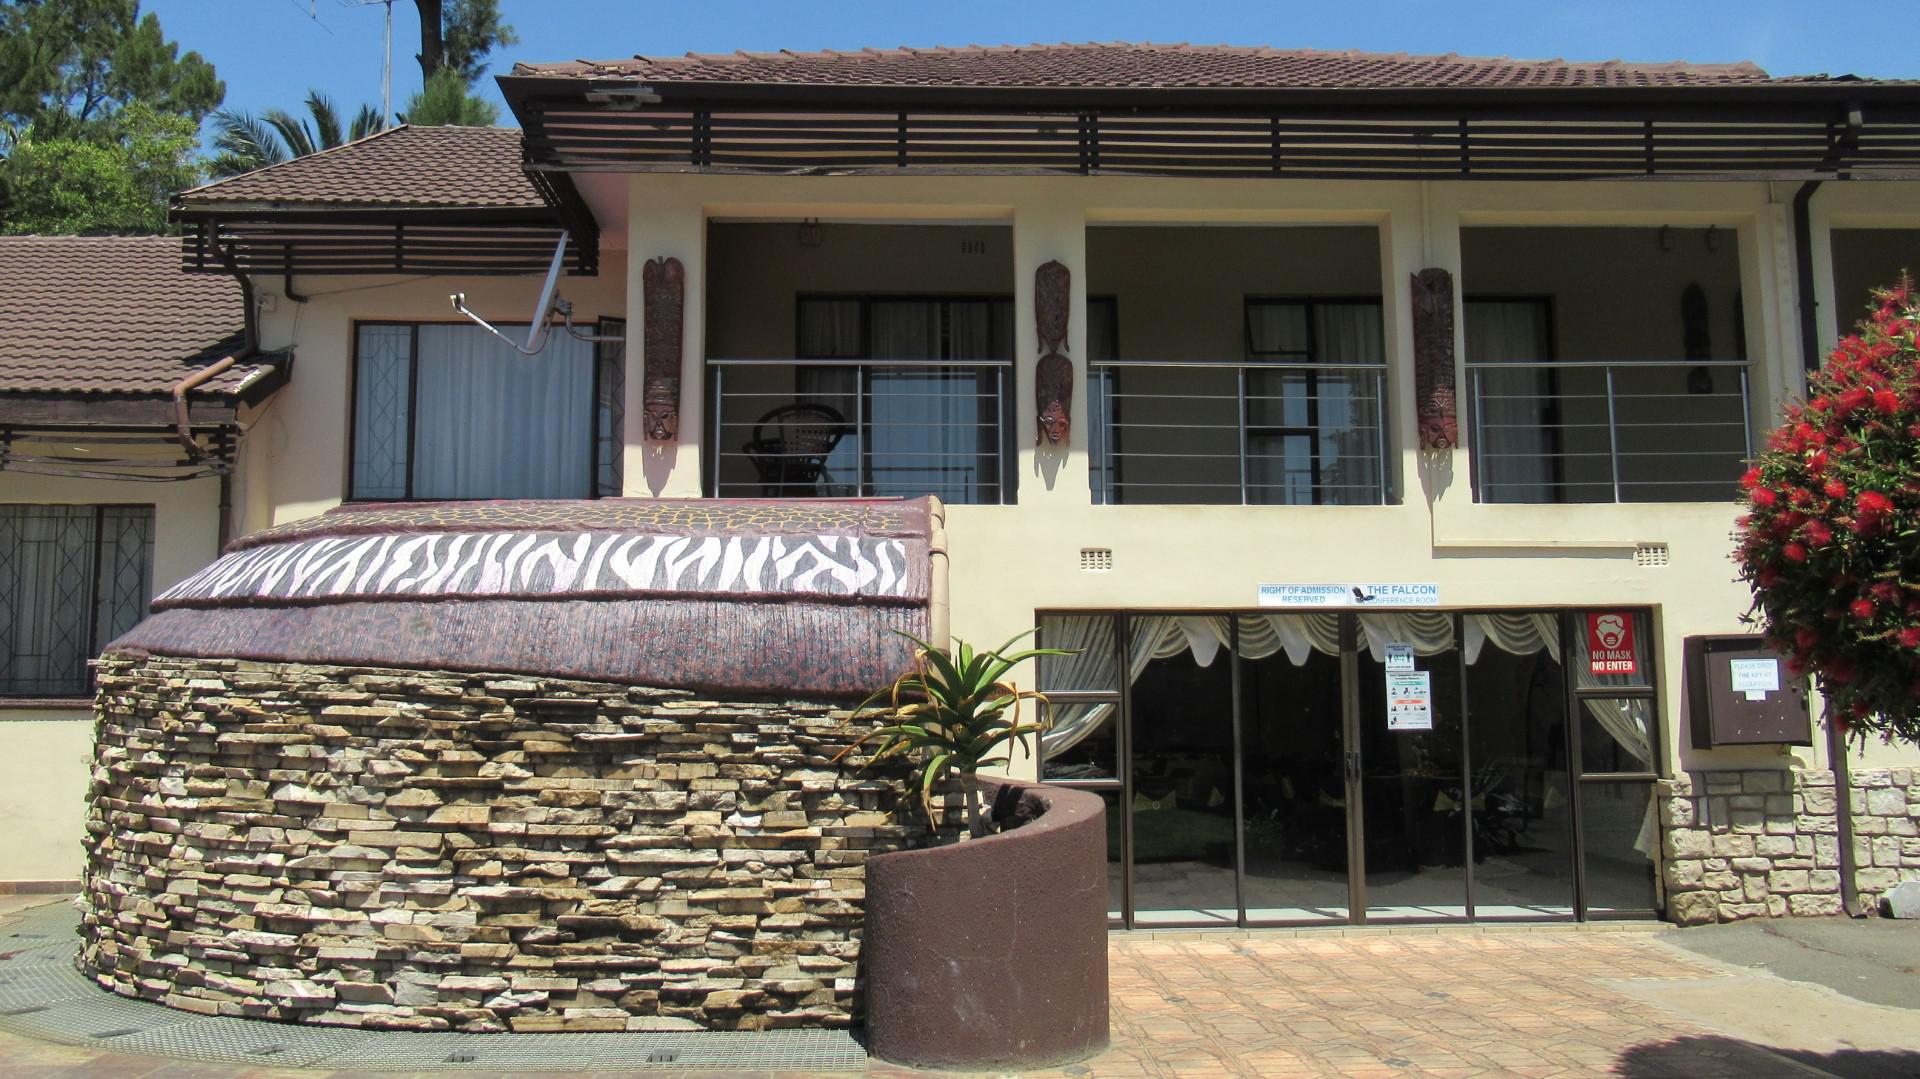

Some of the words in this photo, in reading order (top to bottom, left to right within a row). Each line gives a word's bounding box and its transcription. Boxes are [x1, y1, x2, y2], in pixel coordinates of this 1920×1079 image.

[1261, 586, 1286, 594] RIGHT
[1288, 586, 1300, 594] OF
[1301, 586, 1346, 594] ADMISSION
[1367, 585, 1389, 594] THE
[1392, 585, 1436, 594] FALCON
[1282, 595, 1326, 603] RESERVED
[1592, 650, 1605, 660] NO
[1606, 650, 1631, 660] MASK
[1592, 660, 1605, 671] NO
[1606, 660, 1633, 671] ENTER
